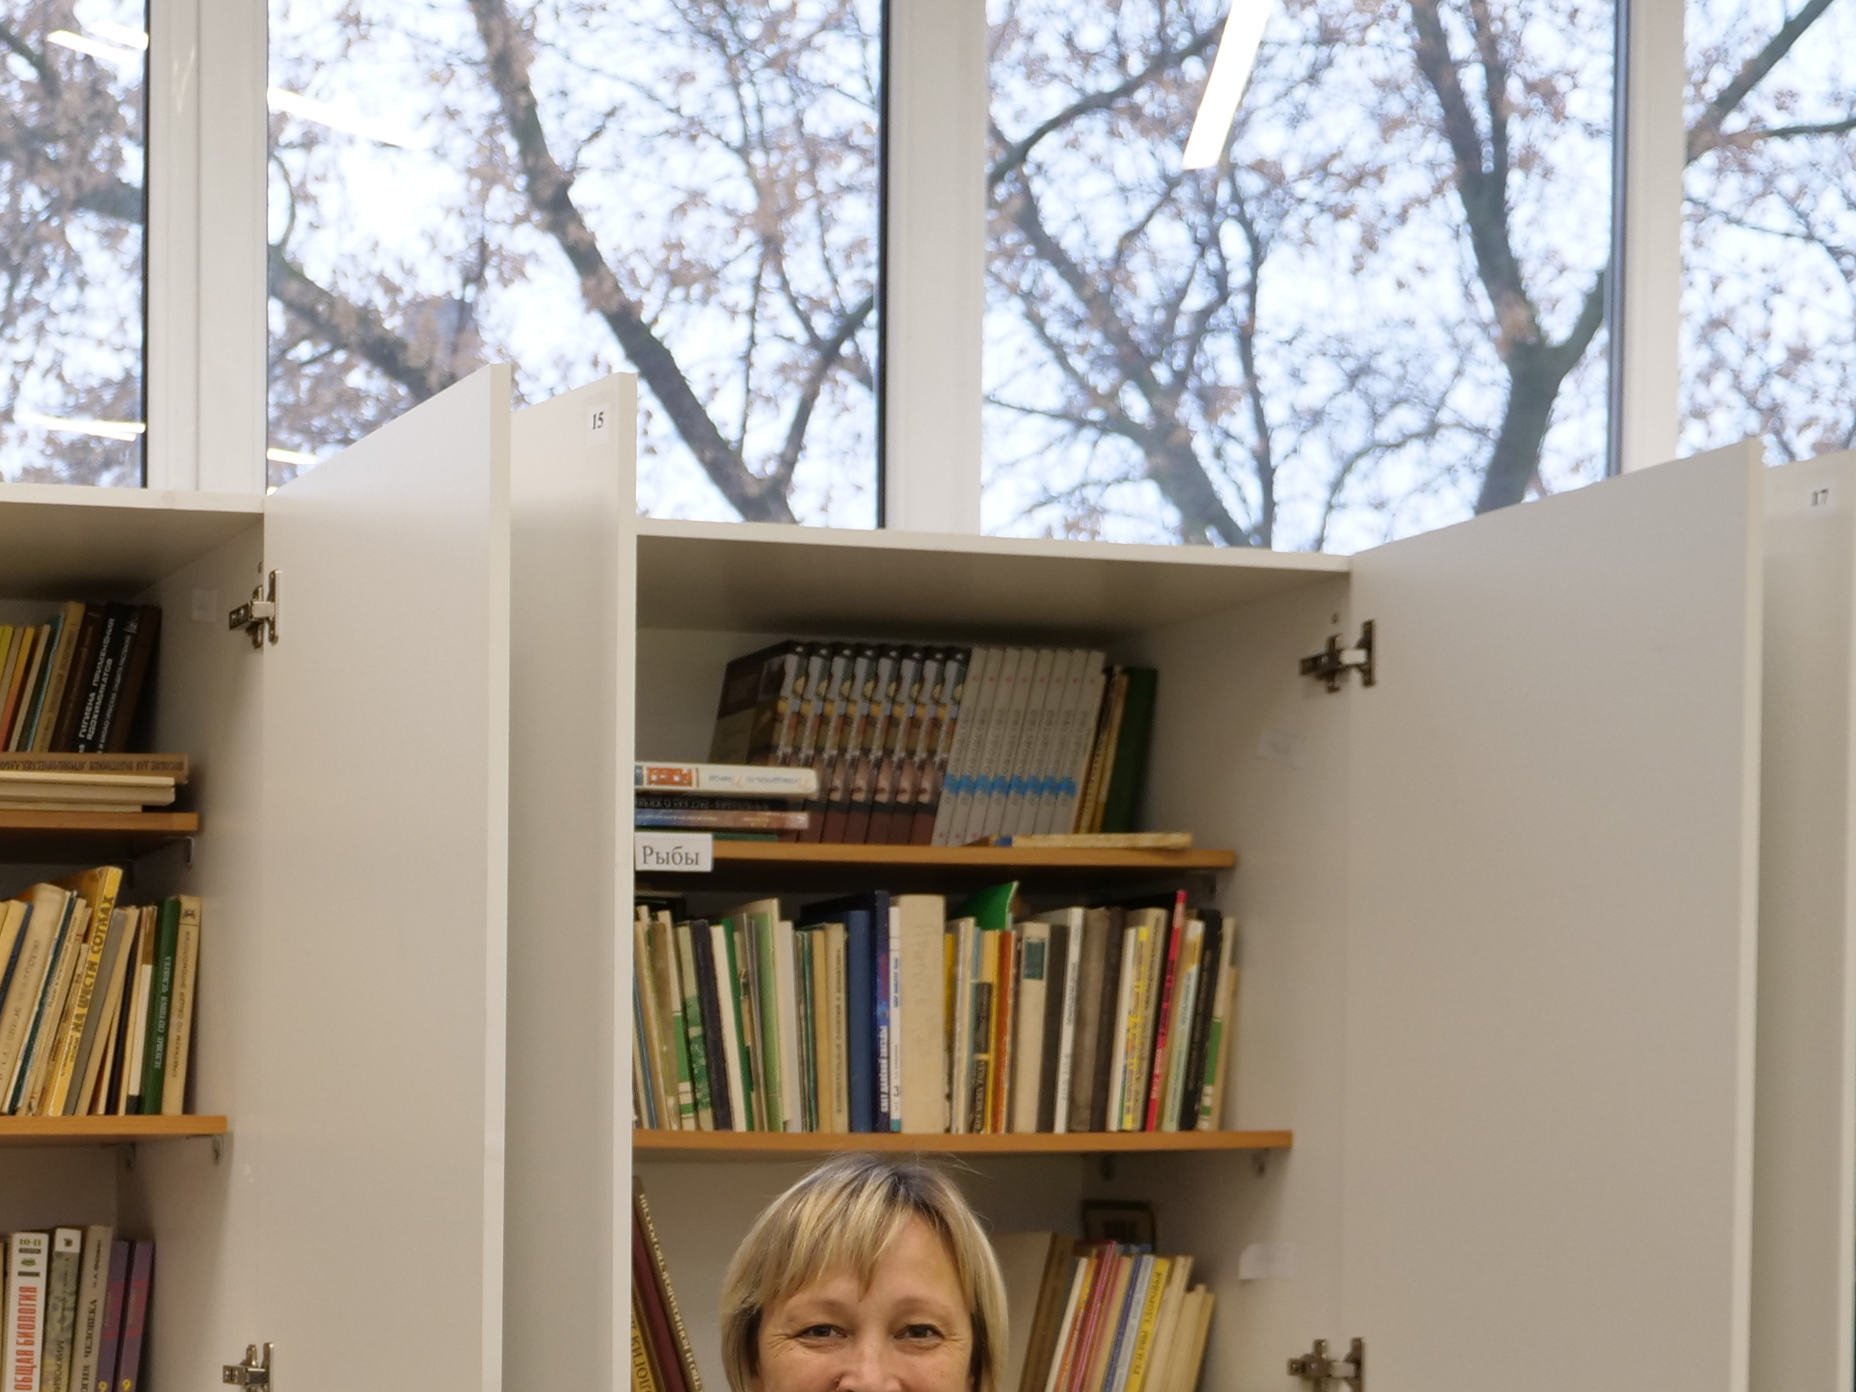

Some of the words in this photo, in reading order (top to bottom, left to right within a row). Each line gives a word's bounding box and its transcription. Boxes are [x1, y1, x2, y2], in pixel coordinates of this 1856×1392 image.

[591, 411, 605, 431] 15
[78, 692, 96, 738] ГИГИЕНА
[642, 846, 699, 866] Рыбы
[91, 895, 114, 955] СОТКАХ
[77, 959, 98, 1009] ШЕСТИ
[72, 1012, 87, 1033] НА
[16, 1286, 37, 1345] БИОЛОГИЯ
[83, 1298, 98, 1357] ЧЕЛОВЕКА
[14, 1350, 37, 1390] ОБЩАЯ
